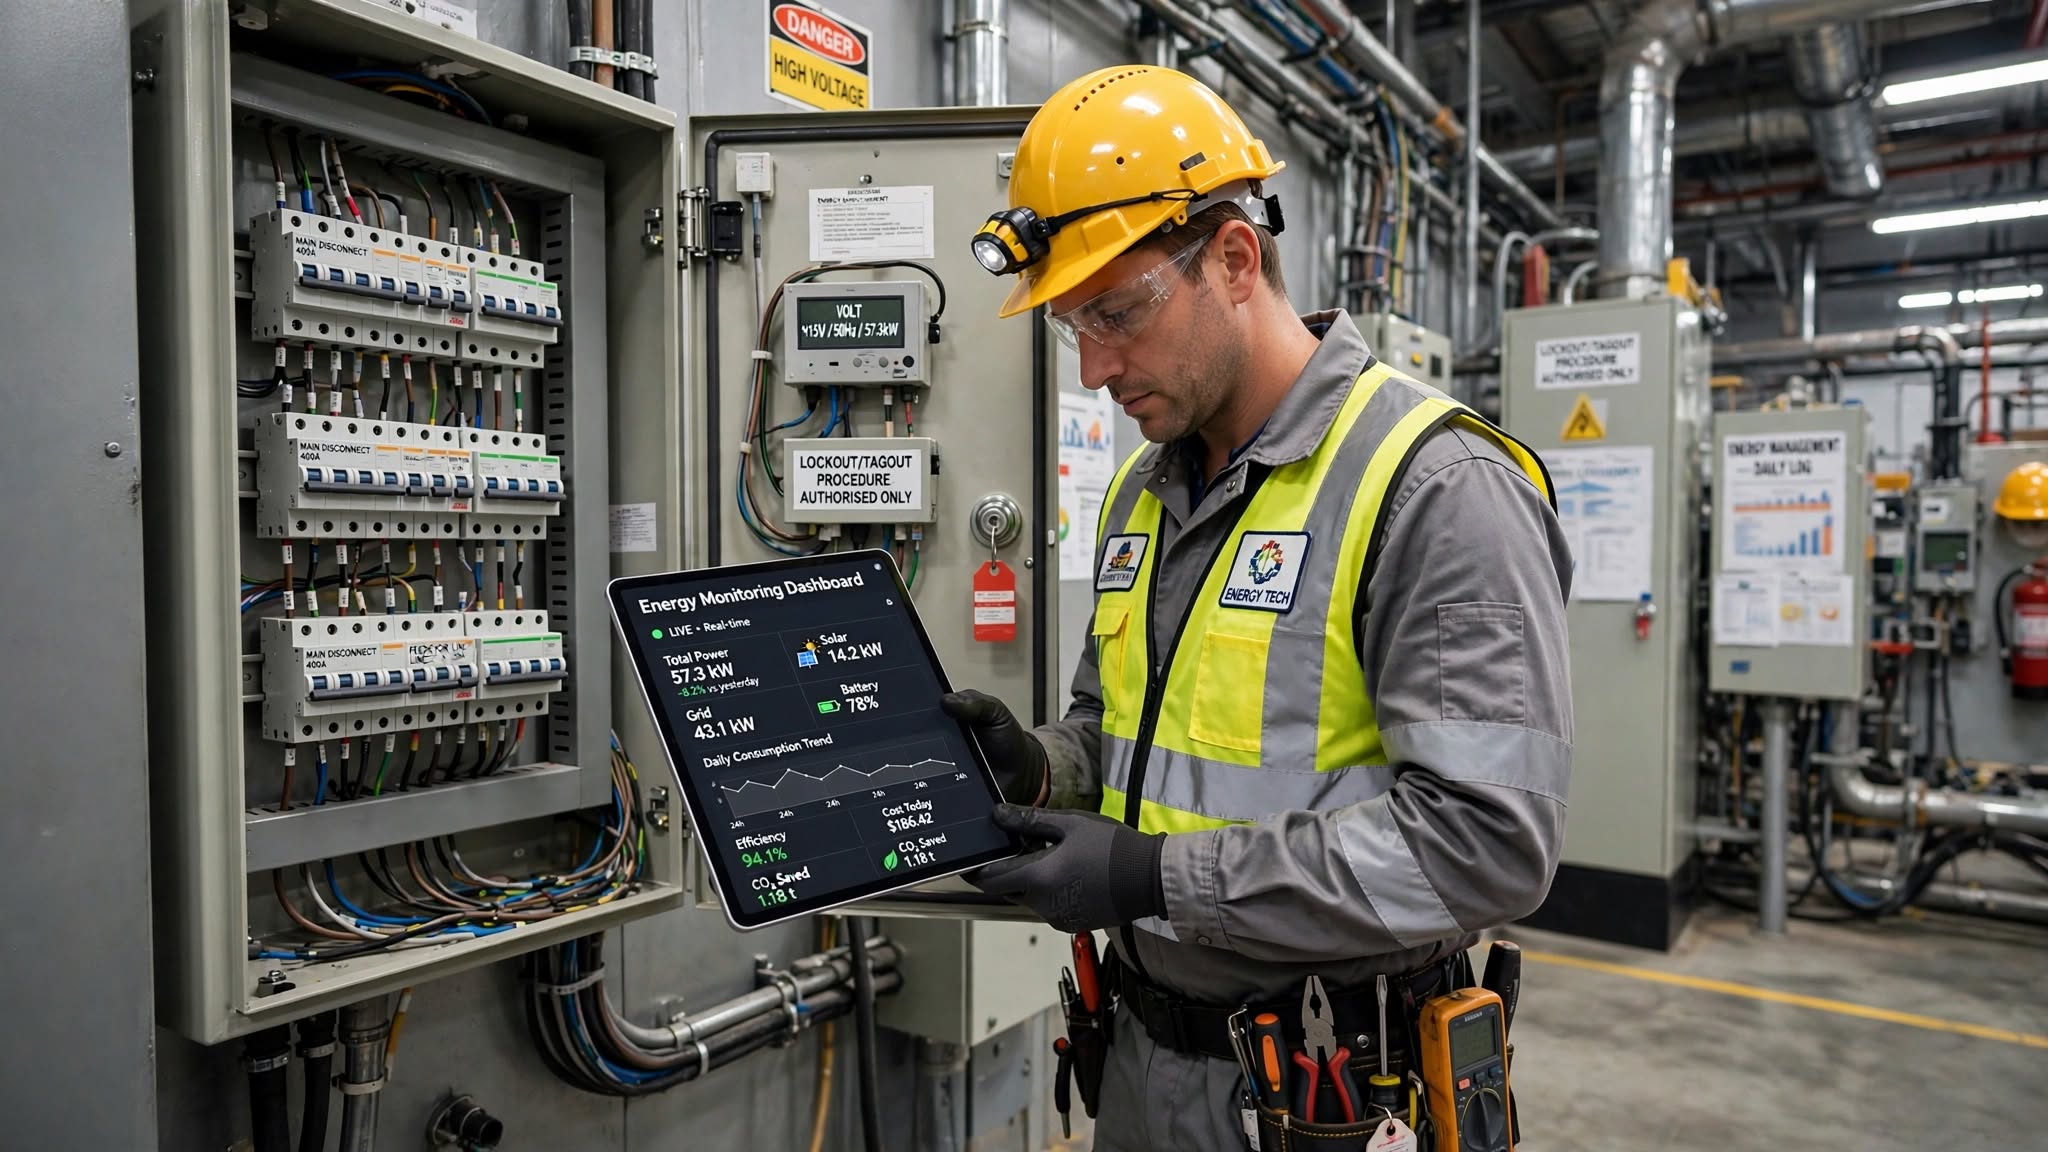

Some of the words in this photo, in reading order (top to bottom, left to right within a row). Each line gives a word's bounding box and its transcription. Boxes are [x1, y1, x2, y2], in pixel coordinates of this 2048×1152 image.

[787, 9, 854, 59] DANGER
[774, 52, 806, 84] HIGH
[810, 68, 864, 108] VOLTAGE
[296, 237, 316, 247] MAIN
[319, 240, 368, 256] DISCONNECT
[296, 247, 315, 256] 400A
[836, 304, 862, 318] VOLT
[300, 442, 320, 451] MAIN
[322, 443, 370, 454] DISCONNECT
[300, 452, 320, 460] 400A
[800, 455, 912, 470] LOCKOUT/TAGOUT
[817, 473, 891, 486] PROCEDURE
[800, 491, 877, 504] AUTHORISED
[880, 491, 912, 504] ONLY
[638, 596, 696, 613] Energy
[699, 584, 784, 606] Monitoring
[784, 571, 864, 595] Dashboard
[1225, 588, 1263, 602] ENERGY
[1265, 589, 1291, 605] TECH
[669, 624, 693, 637] LIVE
[703, 618, 751, 632] Real-time
[820, 632, 847, 646] Solar
[306, 650, 325, 658] MAIN
[328, 647, 376, 658] DISCONNECT
[663, 652, 693, 666] Total
[694, 649, 728, 662] Power
[827, 646, 860, 663] 14.2
[859, 642, 883, 658] kW
[306, 660, 326, 668] 400A
[671, 666, 706, 684] 57.3
[707, 662, 734, 679] kW
[678, 684, 706, 697] -8.2%
[719, 677, 759, 694] yesterday
[840, 681, 878, 695] Battery
[845, 695, 879, 713] 78%
[686, 706, 712, 721] Grid
[694, 721, 727, 739] 43.1
[729, 716, 754, 734] kW
[703, 754, 731, 768] Daily
[733, 742, 802, 762] Consumption
[801, 733, 833, 749] Trend
[955, 772, 968, 781] 24h
[914, 781, 928, 789] 24h
[872, 790, 886, 798] 24h
[826, 799, 841, 808] 24h
[882, 805, 904, 817] Cost
[903, 799, 933, 811] Today
[779, 810, 794, 819] 24h
[886, 812, 934, 833] $186.42
[730, 821, 745, 829] 24h
[735, 831, 786, 850] Efficiency
[919, 832, 947, 848] Saved
[741, 847, 787, 868] 94.1%
[904, 852, 928, 867] 1.18
[928, 851, 936, 861] t
[758, 889, 787, 907] 1.18
[788, 888, 797, 899] t
